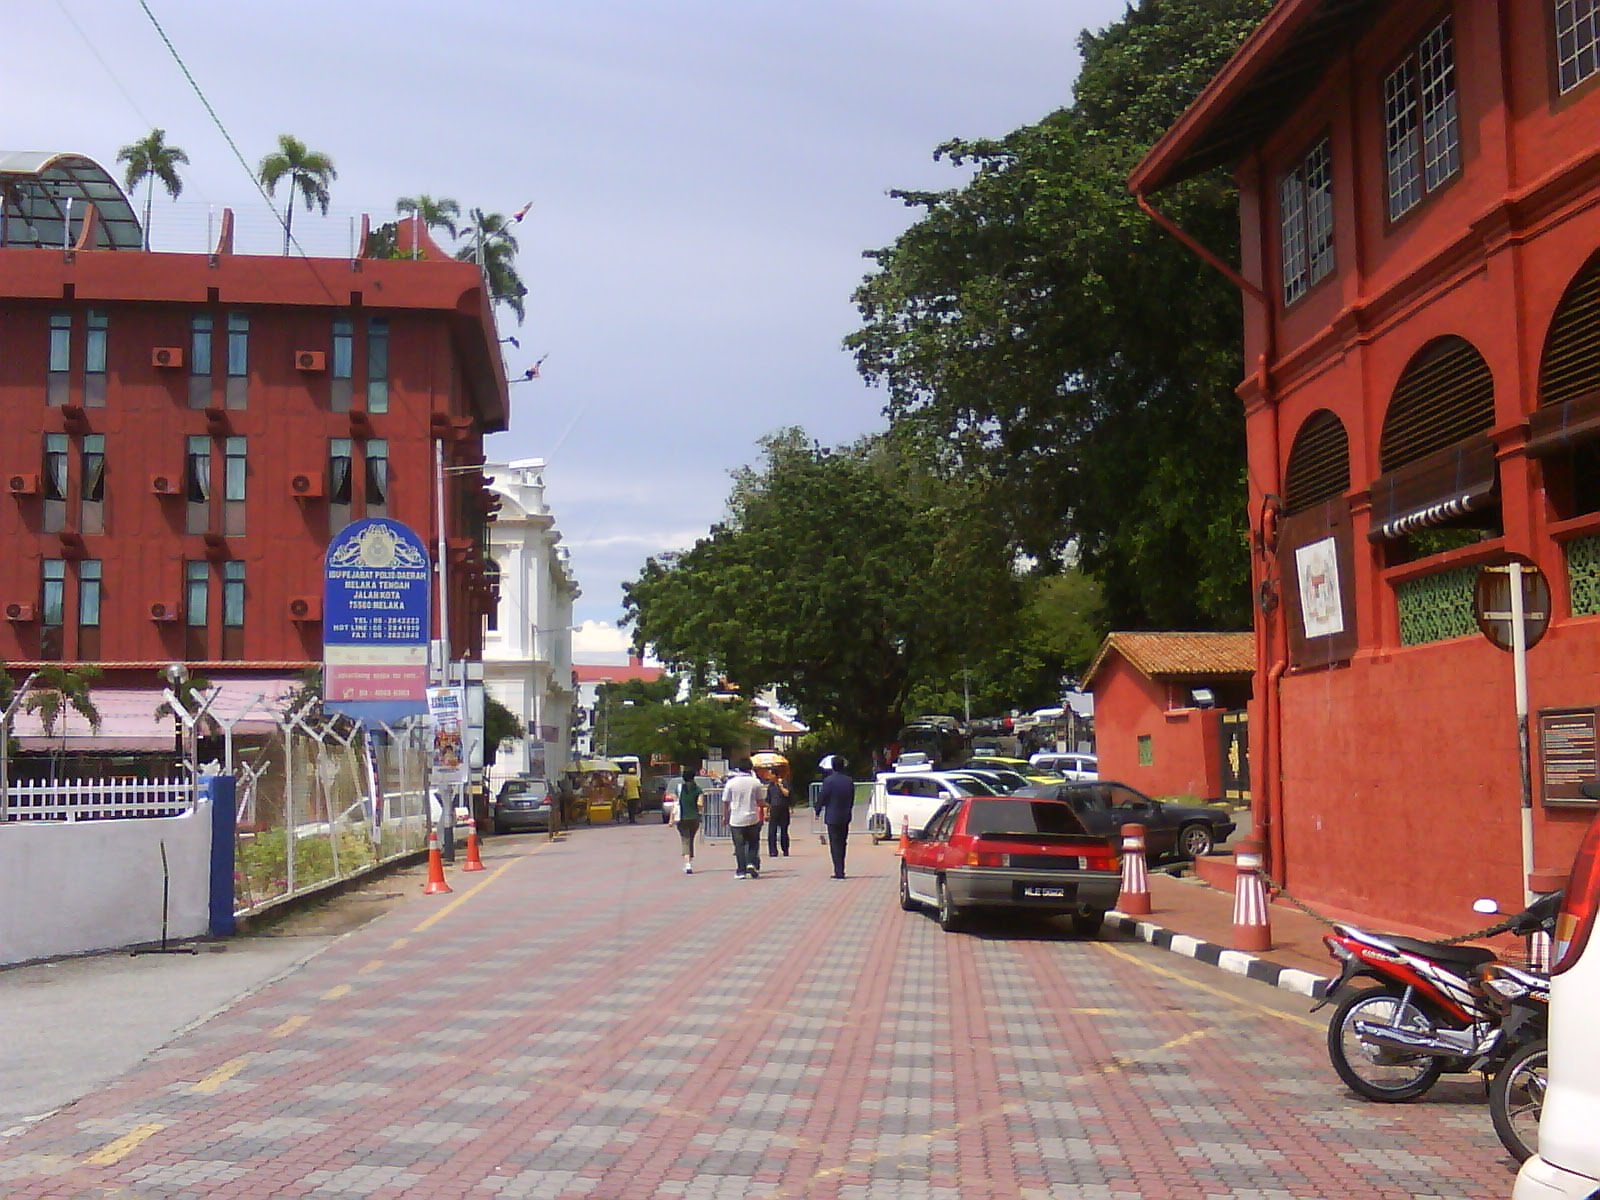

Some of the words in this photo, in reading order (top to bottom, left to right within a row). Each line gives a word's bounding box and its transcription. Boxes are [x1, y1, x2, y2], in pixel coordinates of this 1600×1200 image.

[342, 570, 373, 580] PEJABAT
[374, 571, 395, 580] POLIS
[397, 571, 427, 580] DAERAH
[345, 581, 377, 589] MELAKA
[379, 581, 410, 590] TENGAH
[353, 590, 378, 599] JALAN
[380, 591, 401, 600] KOTA
[373, 601, 405, 610] MELAKA
[352, 631, 367, 639] FAX
